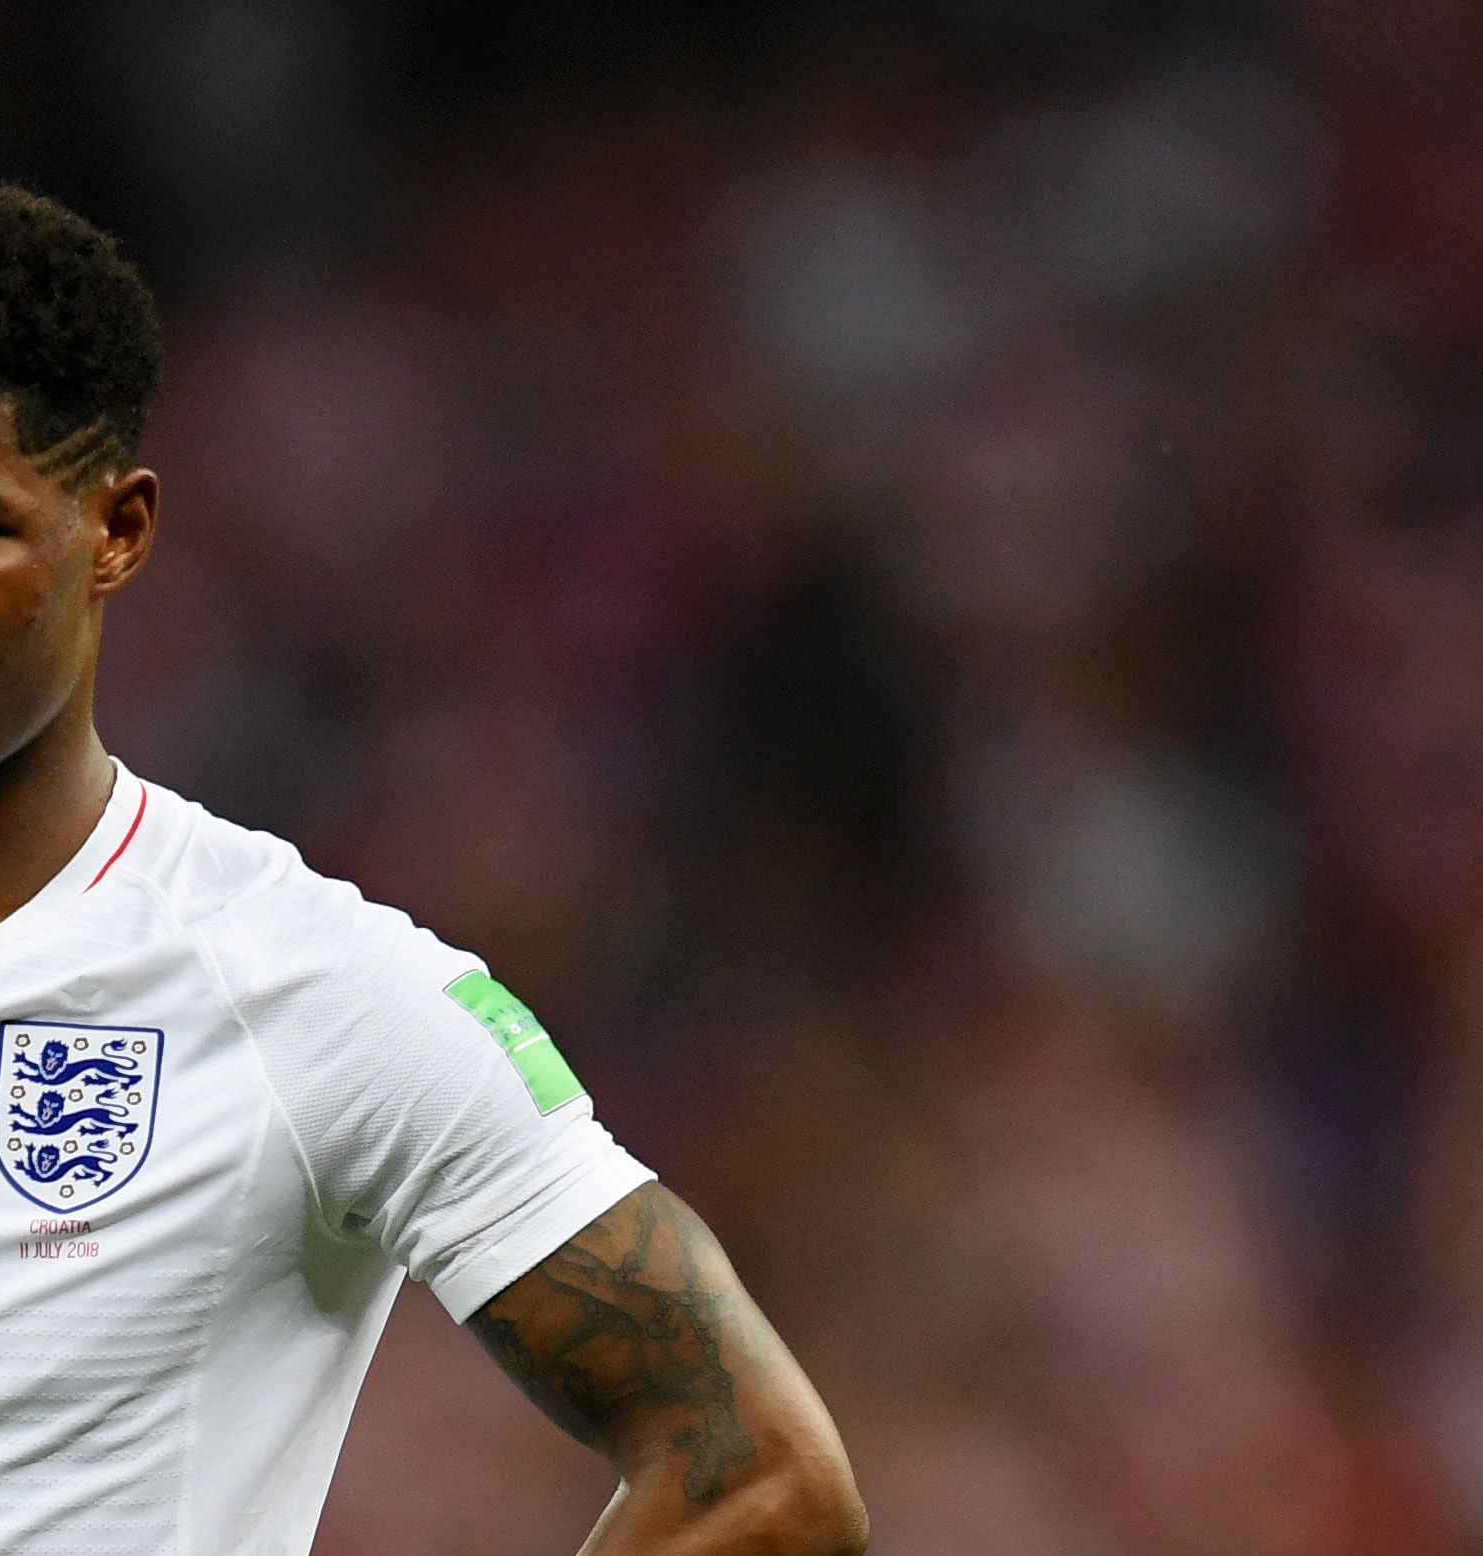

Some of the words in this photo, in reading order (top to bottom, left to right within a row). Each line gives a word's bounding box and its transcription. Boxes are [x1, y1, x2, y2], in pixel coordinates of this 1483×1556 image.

[29, 1219, 92, 1235] CROATIA
[19, 1242, 29, 1259] 11
[33, 1242, 63, 1259] JULY
[67, 1241, 100, 1258] 2018
